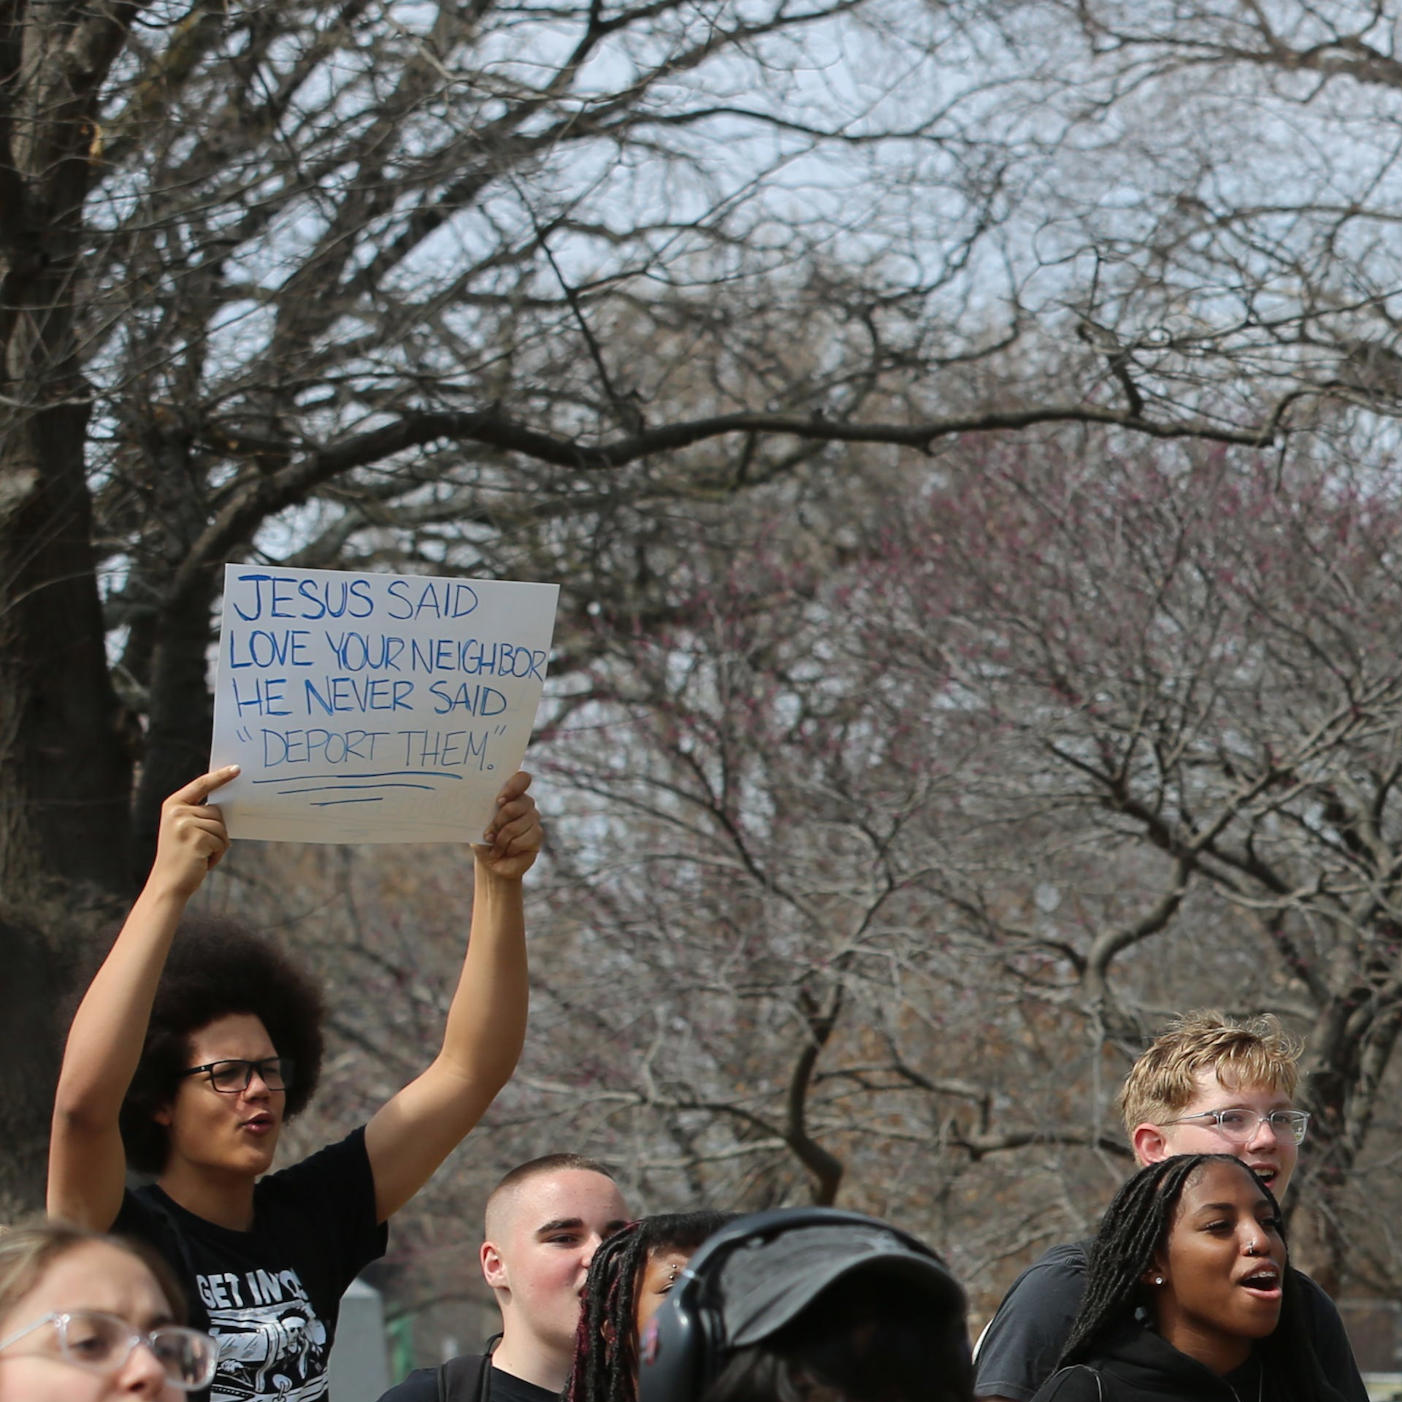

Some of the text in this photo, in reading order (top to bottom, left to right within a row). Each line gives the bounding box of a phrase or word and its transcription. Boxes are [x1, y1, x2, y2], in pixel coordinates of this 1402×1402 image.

[232, 574, 479, 621] JESUS SAID
[230, 629, 548, 682] LOVE YOUR NEIGHBOR
[232, 675, 509, 717] HE NEVER SAID
[235, 725, 508, 772] "DEPORT THEM."
[196, 1272, 244, 1309] GET
[245, 1269, 283, 1306] IN
